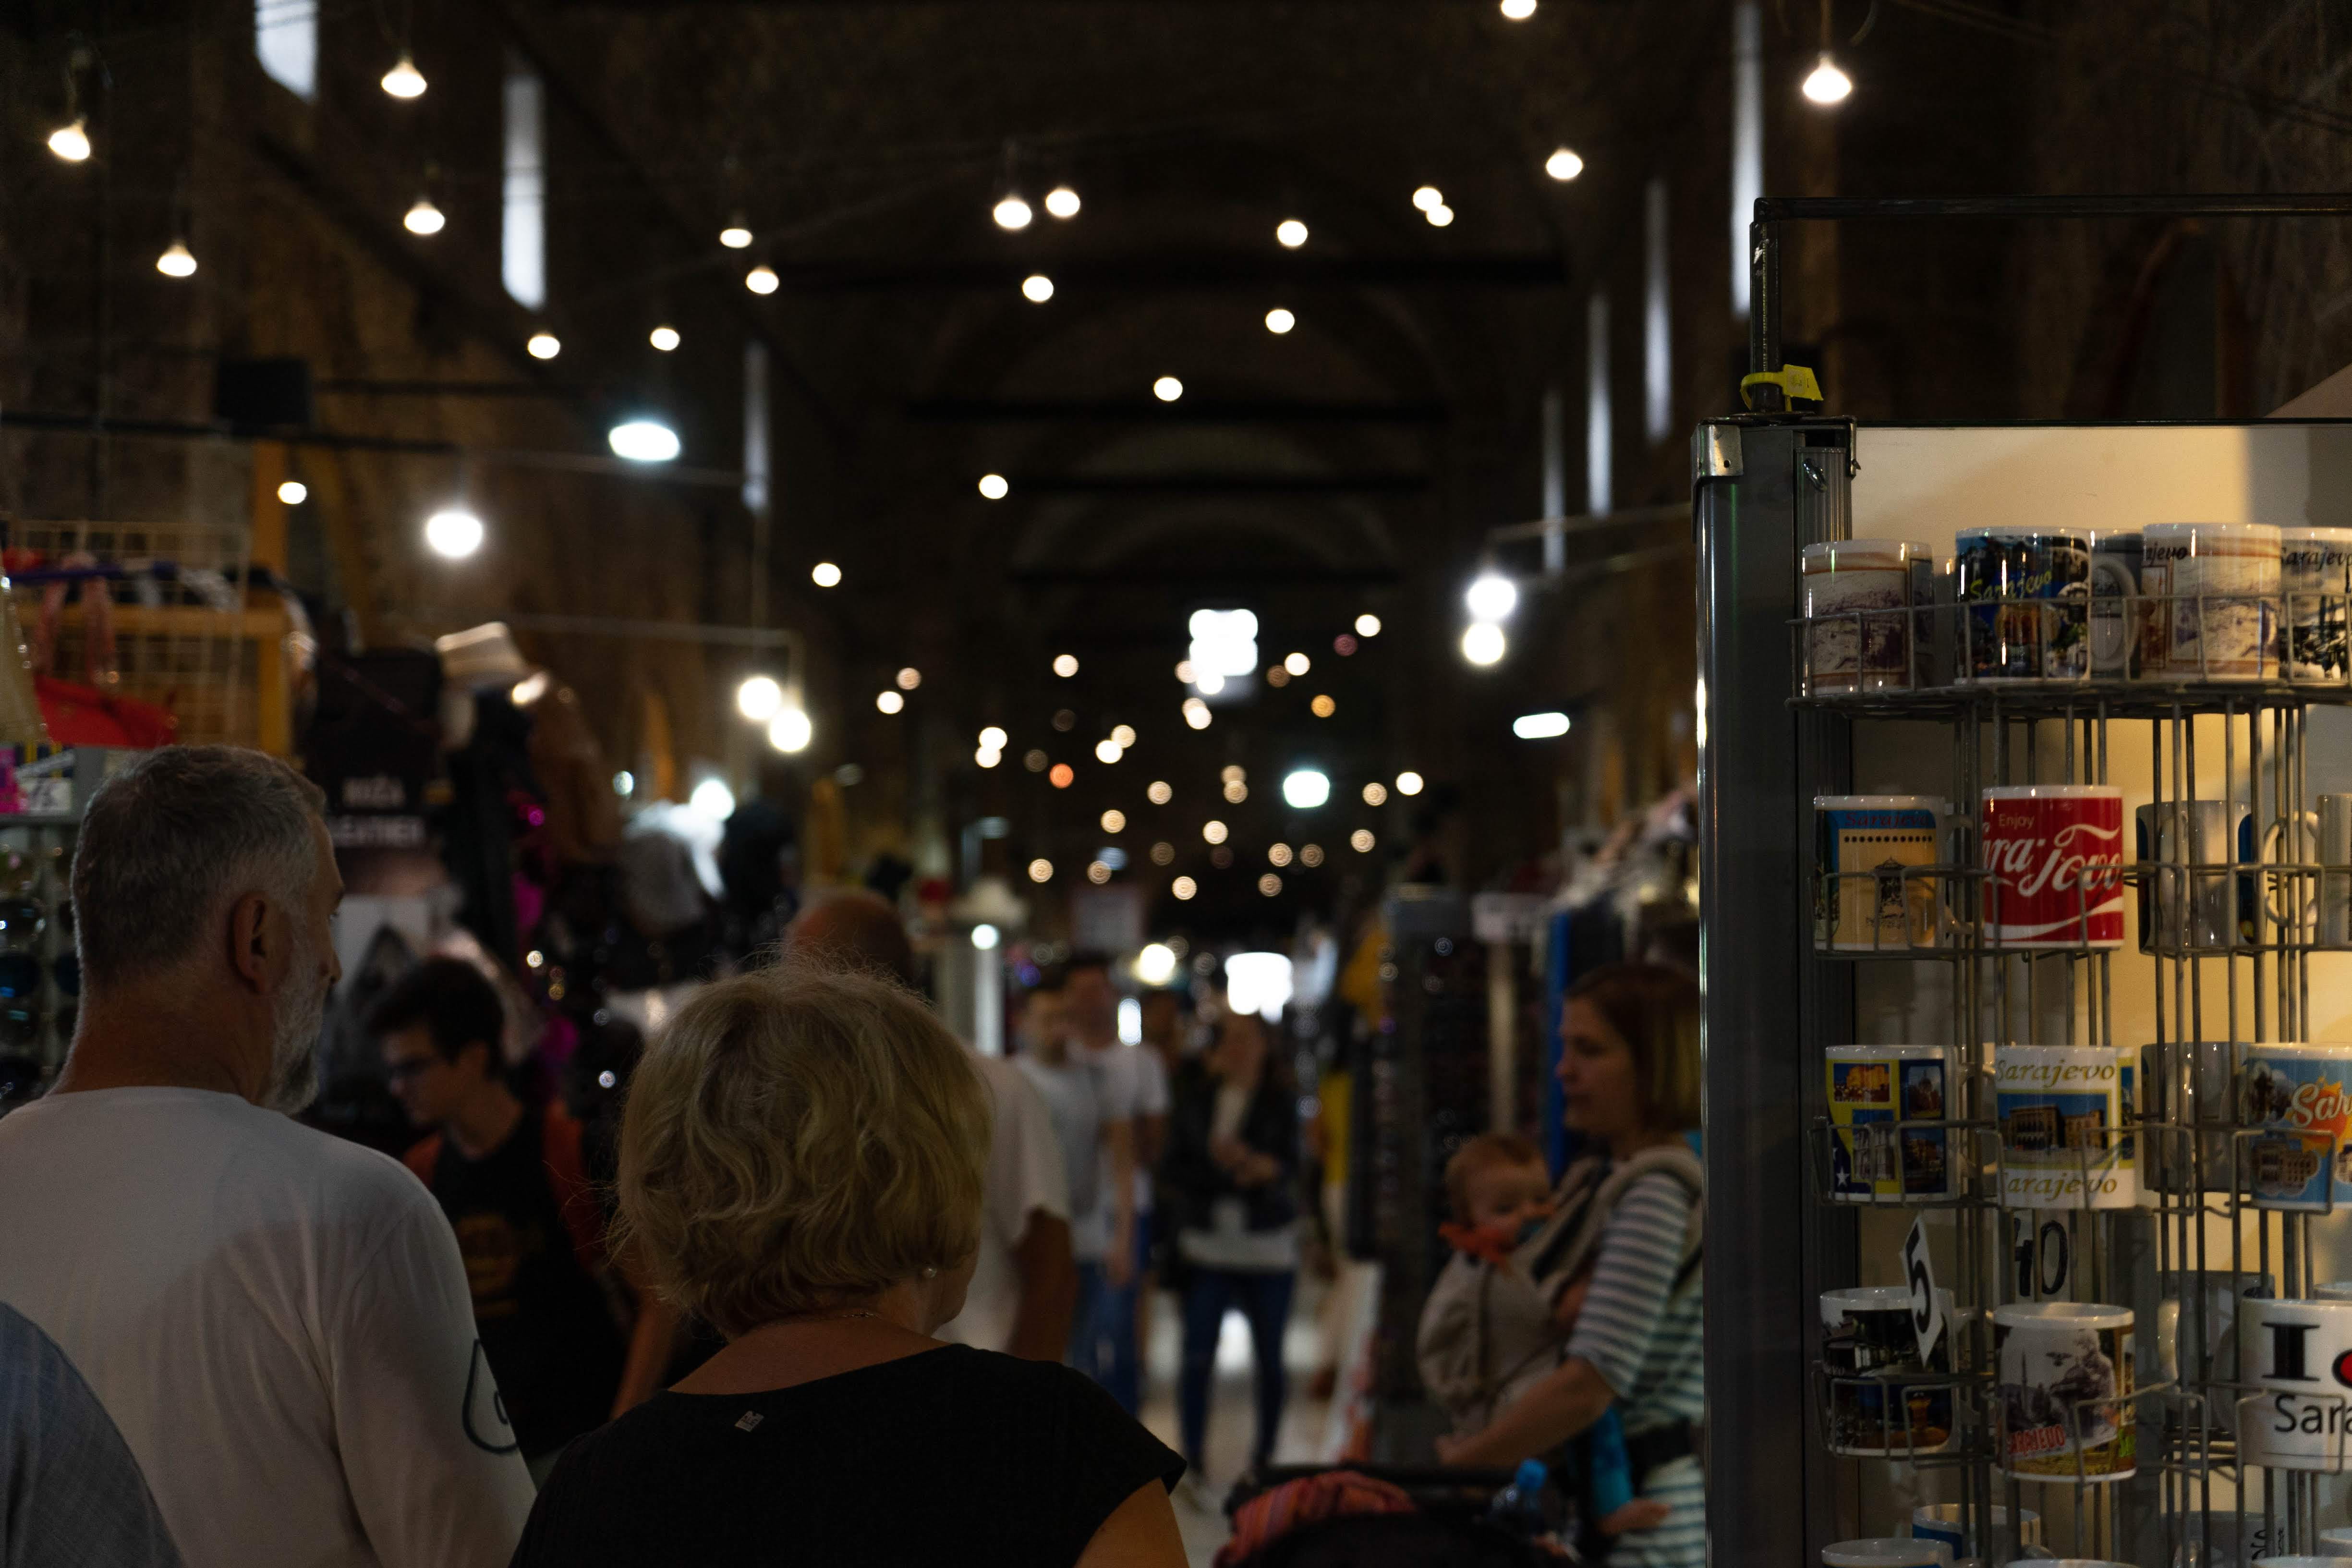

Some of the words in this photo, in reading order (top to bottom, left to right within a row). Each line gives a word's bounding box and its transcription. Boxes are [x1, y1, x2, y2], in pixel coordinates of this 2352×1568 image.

[1999, 813, 2036, 830] Enjoy
[1997, 1059, 2115, 1088] Sarajevo
[2000, 1172, 2118, 1201] arajevo
[1906, 1223, 1930, 1333] 5
[2261, 1322, 2320, 1381] I
